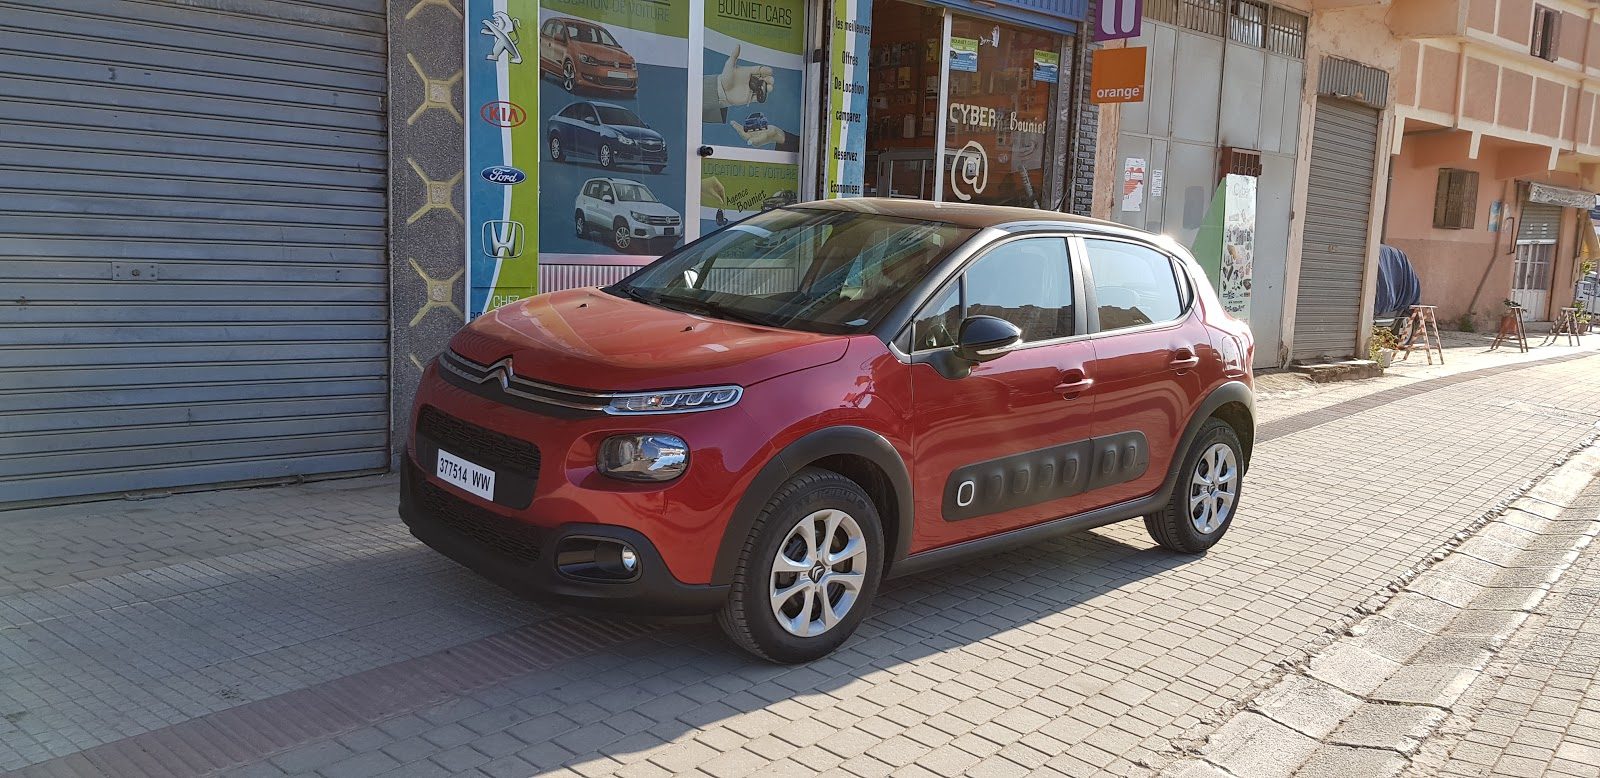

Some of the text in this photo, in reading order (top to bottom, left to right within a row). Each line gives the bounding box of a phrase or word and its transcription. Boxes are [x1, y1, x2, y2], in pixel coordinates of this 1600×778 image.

[718, 0, 792, 26] BOUNIET CARS
[842, 50, 858, 66] Offres
[834, 76, 865, 95] De Location
[1097, 87, 1140, 99] orange
[950, 103, 1047, 134] CYBER Bouniet
[489, 168, 518, 183] Ford
[703, 163, 798, 180] LOCATION DE VOITURE
[726, 188, 749, 206] Agence
[440, 457, 491, 492] 377514 WW
